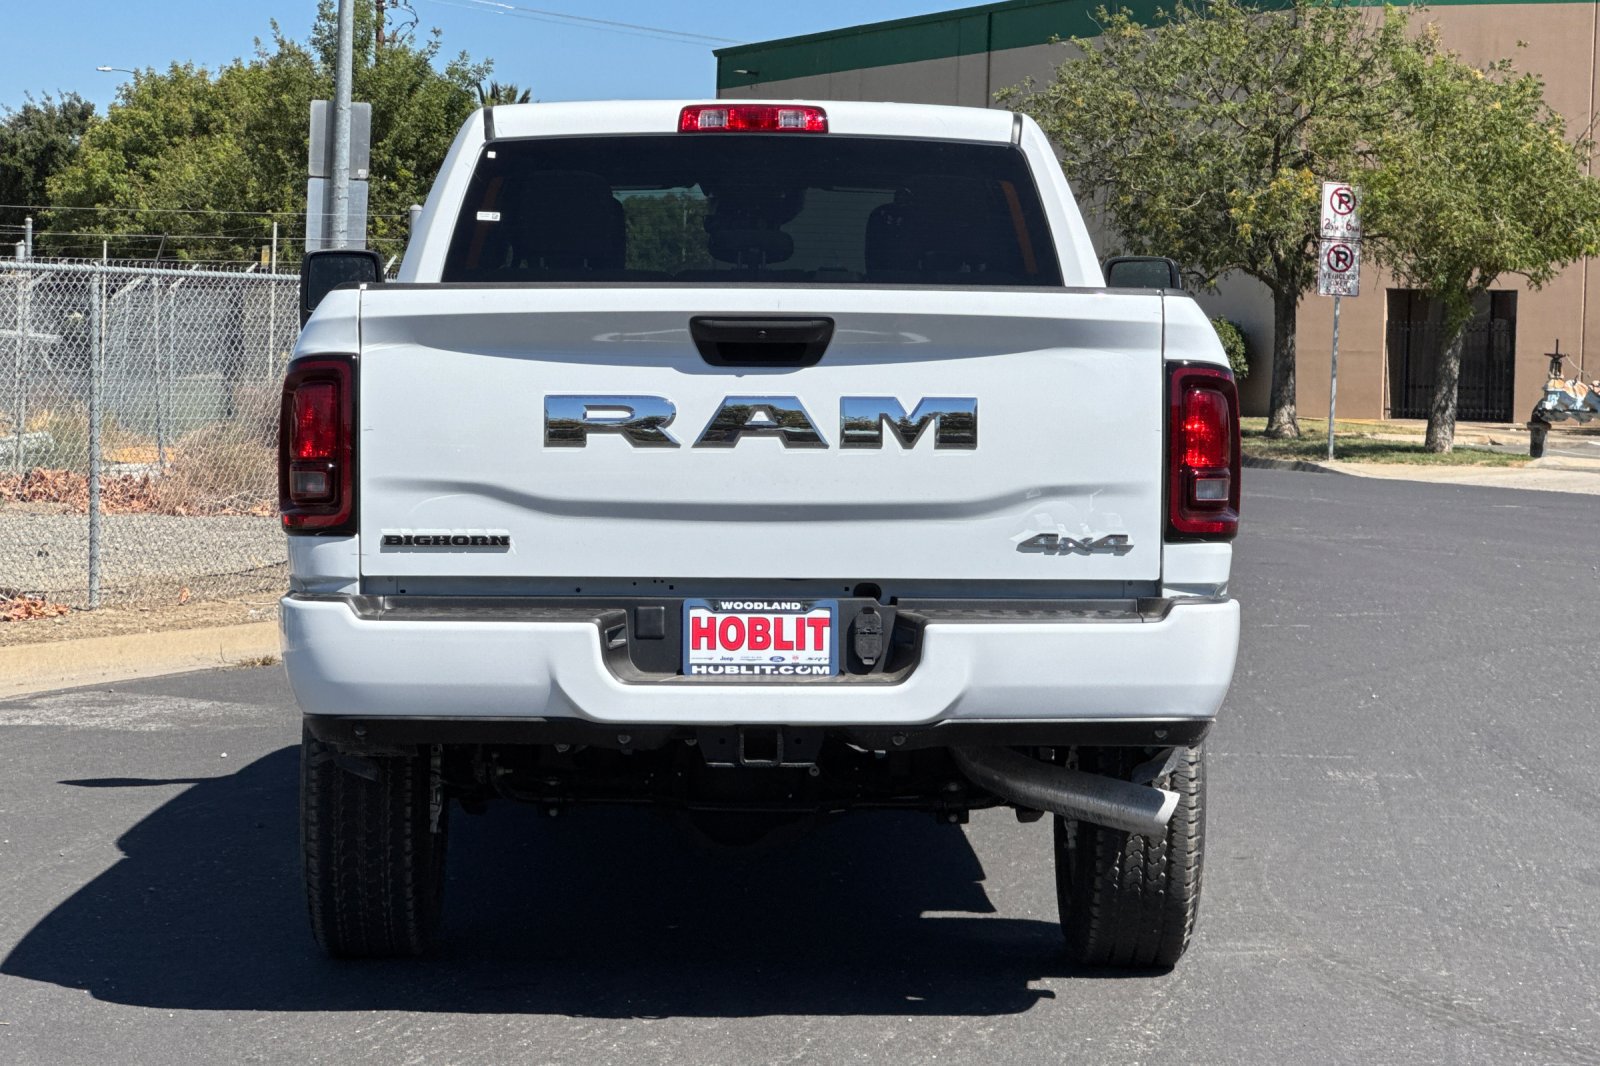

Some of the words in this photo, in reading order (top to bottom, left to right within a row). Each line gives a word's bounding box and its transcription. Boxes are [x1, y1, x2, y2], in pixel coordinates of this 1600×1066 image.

[543, 394, 978, 450] RAM
[381, 534, 510, 551] BIGHORN
[721, 601, 801, 610] WOODLAND
[691, 616, 830, 651] HOBLIT
